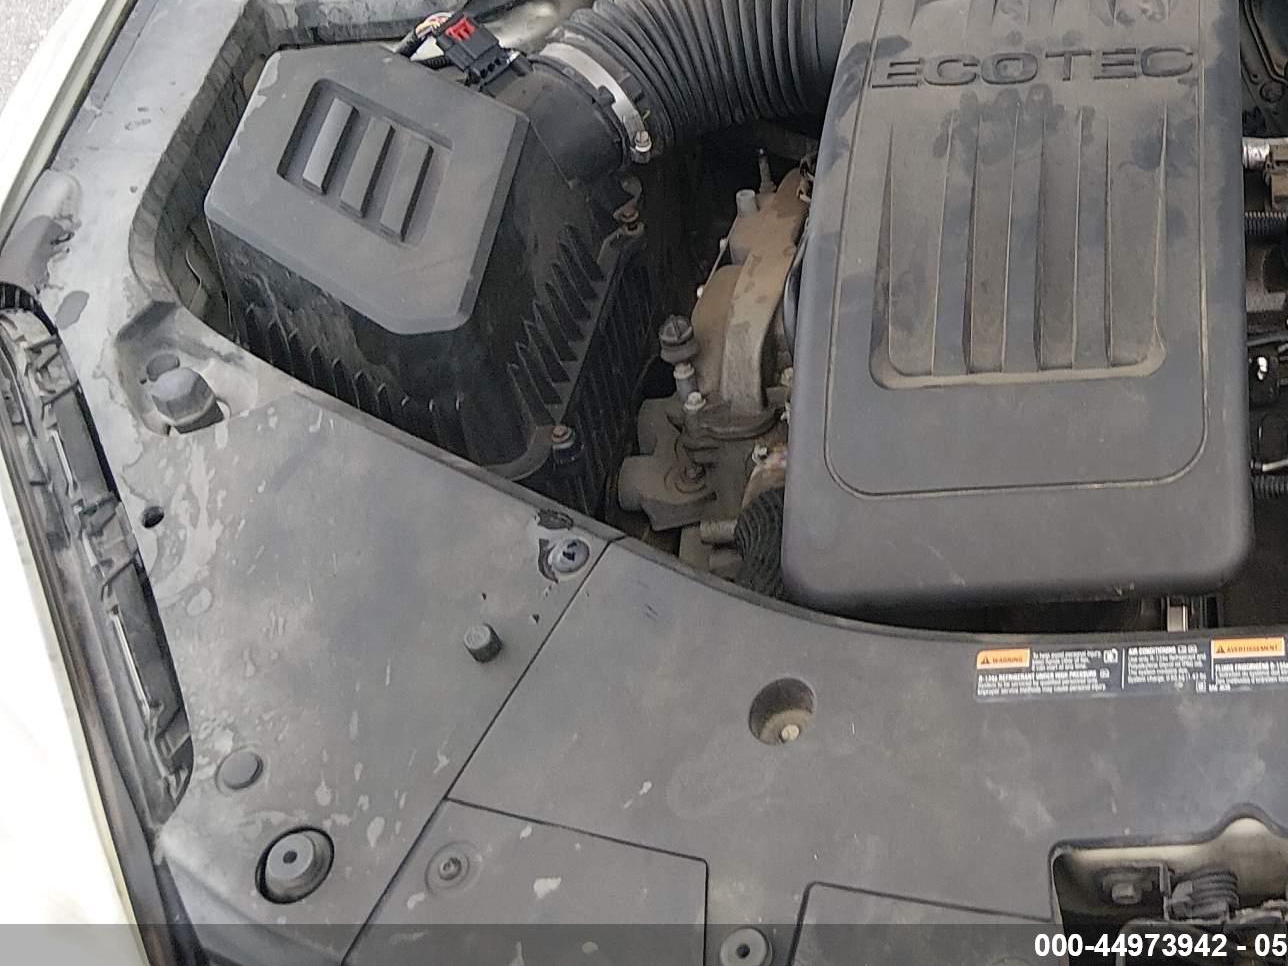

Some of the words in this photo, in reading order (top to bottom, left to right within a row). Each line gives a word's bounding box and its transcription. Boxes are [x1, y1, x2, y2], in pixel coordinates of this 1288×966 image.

[871, 47, 1193, 88] ECOTEC
[1227, 646, 1279, 654] AVERTISSEMENT
[992, 656, 1024, 664] WARNING
